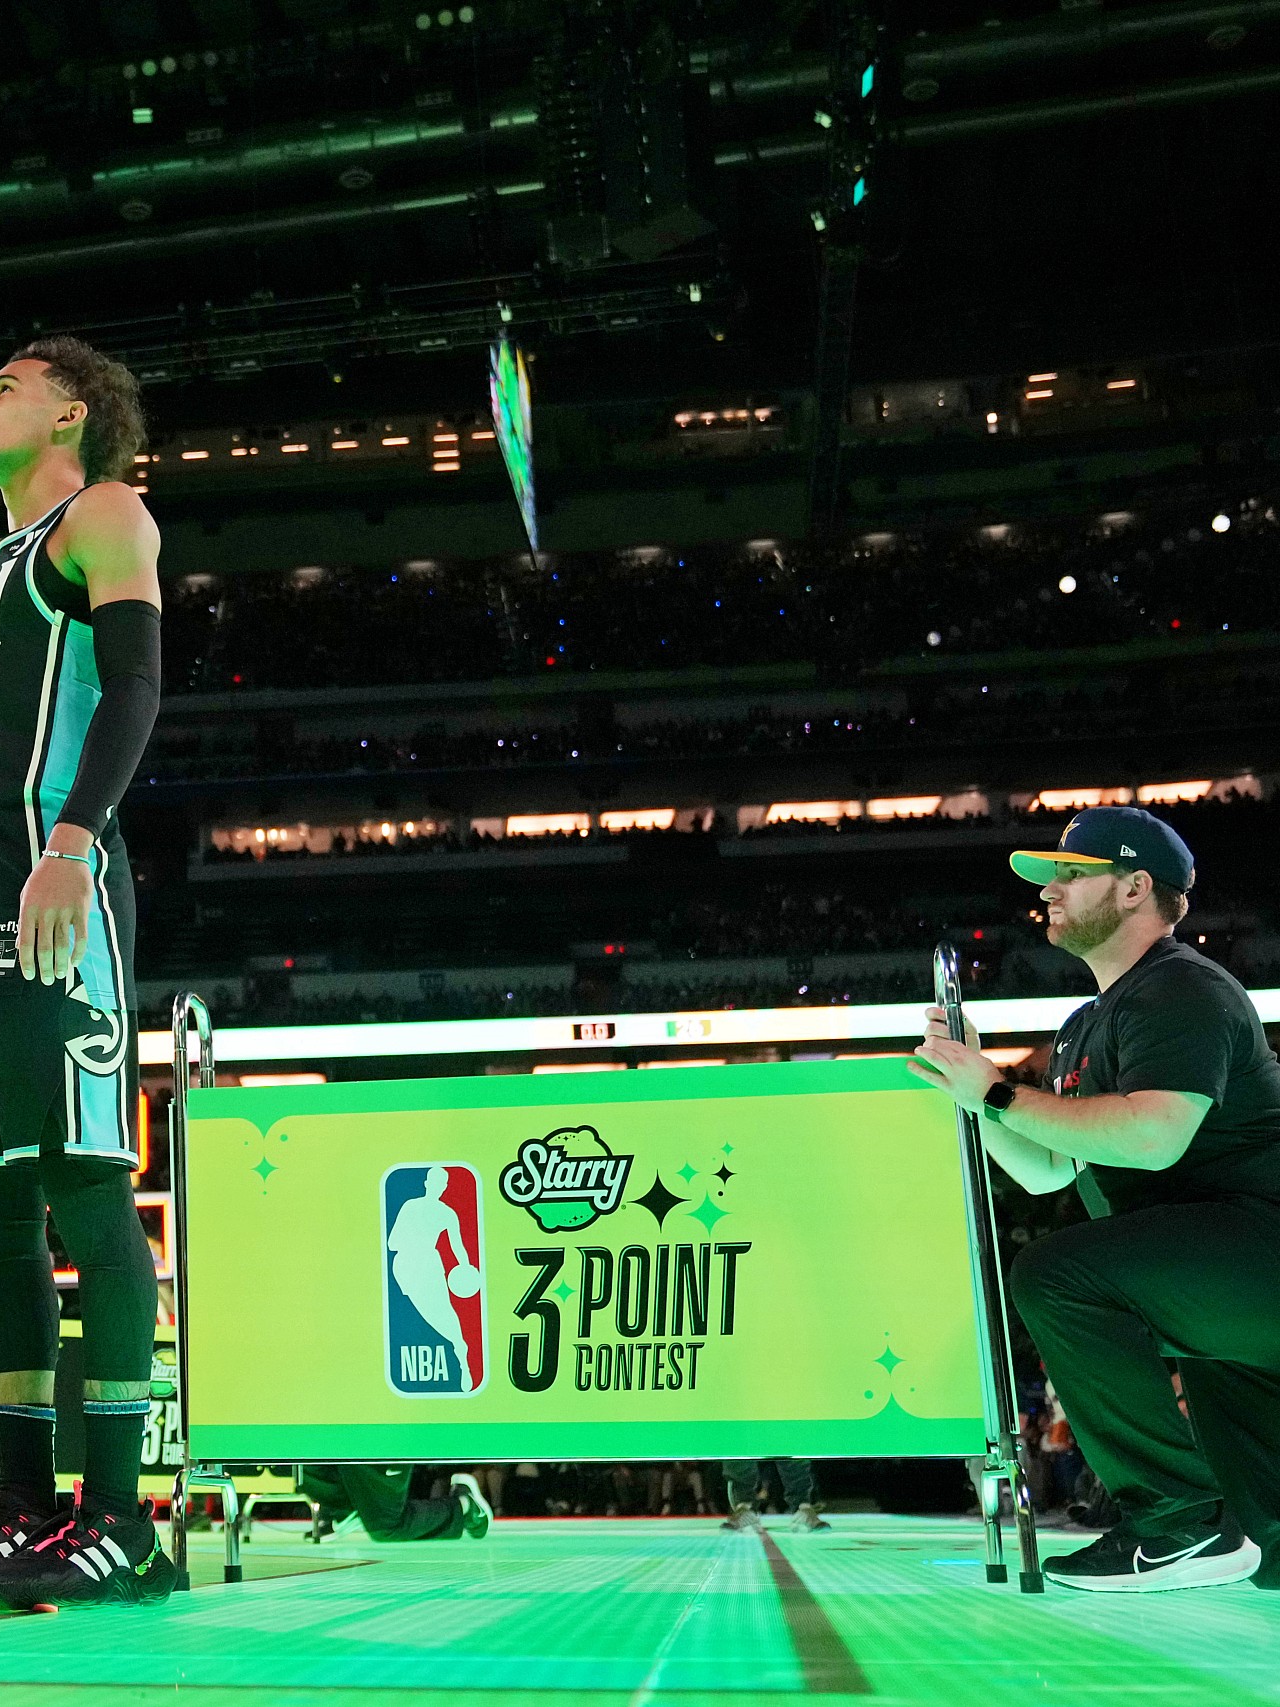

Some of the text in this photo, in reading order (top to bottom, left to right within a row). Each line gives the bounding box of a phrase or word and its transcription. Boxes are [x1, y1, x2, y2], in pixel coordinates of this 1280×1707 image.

[500, 1140, 631, 1213] Starry
[508, 1241, 752, 1393] 3 POINT
[399, 1344, 450, 1383] NBA
[573, 1341, 705, 1392] CONTEST
